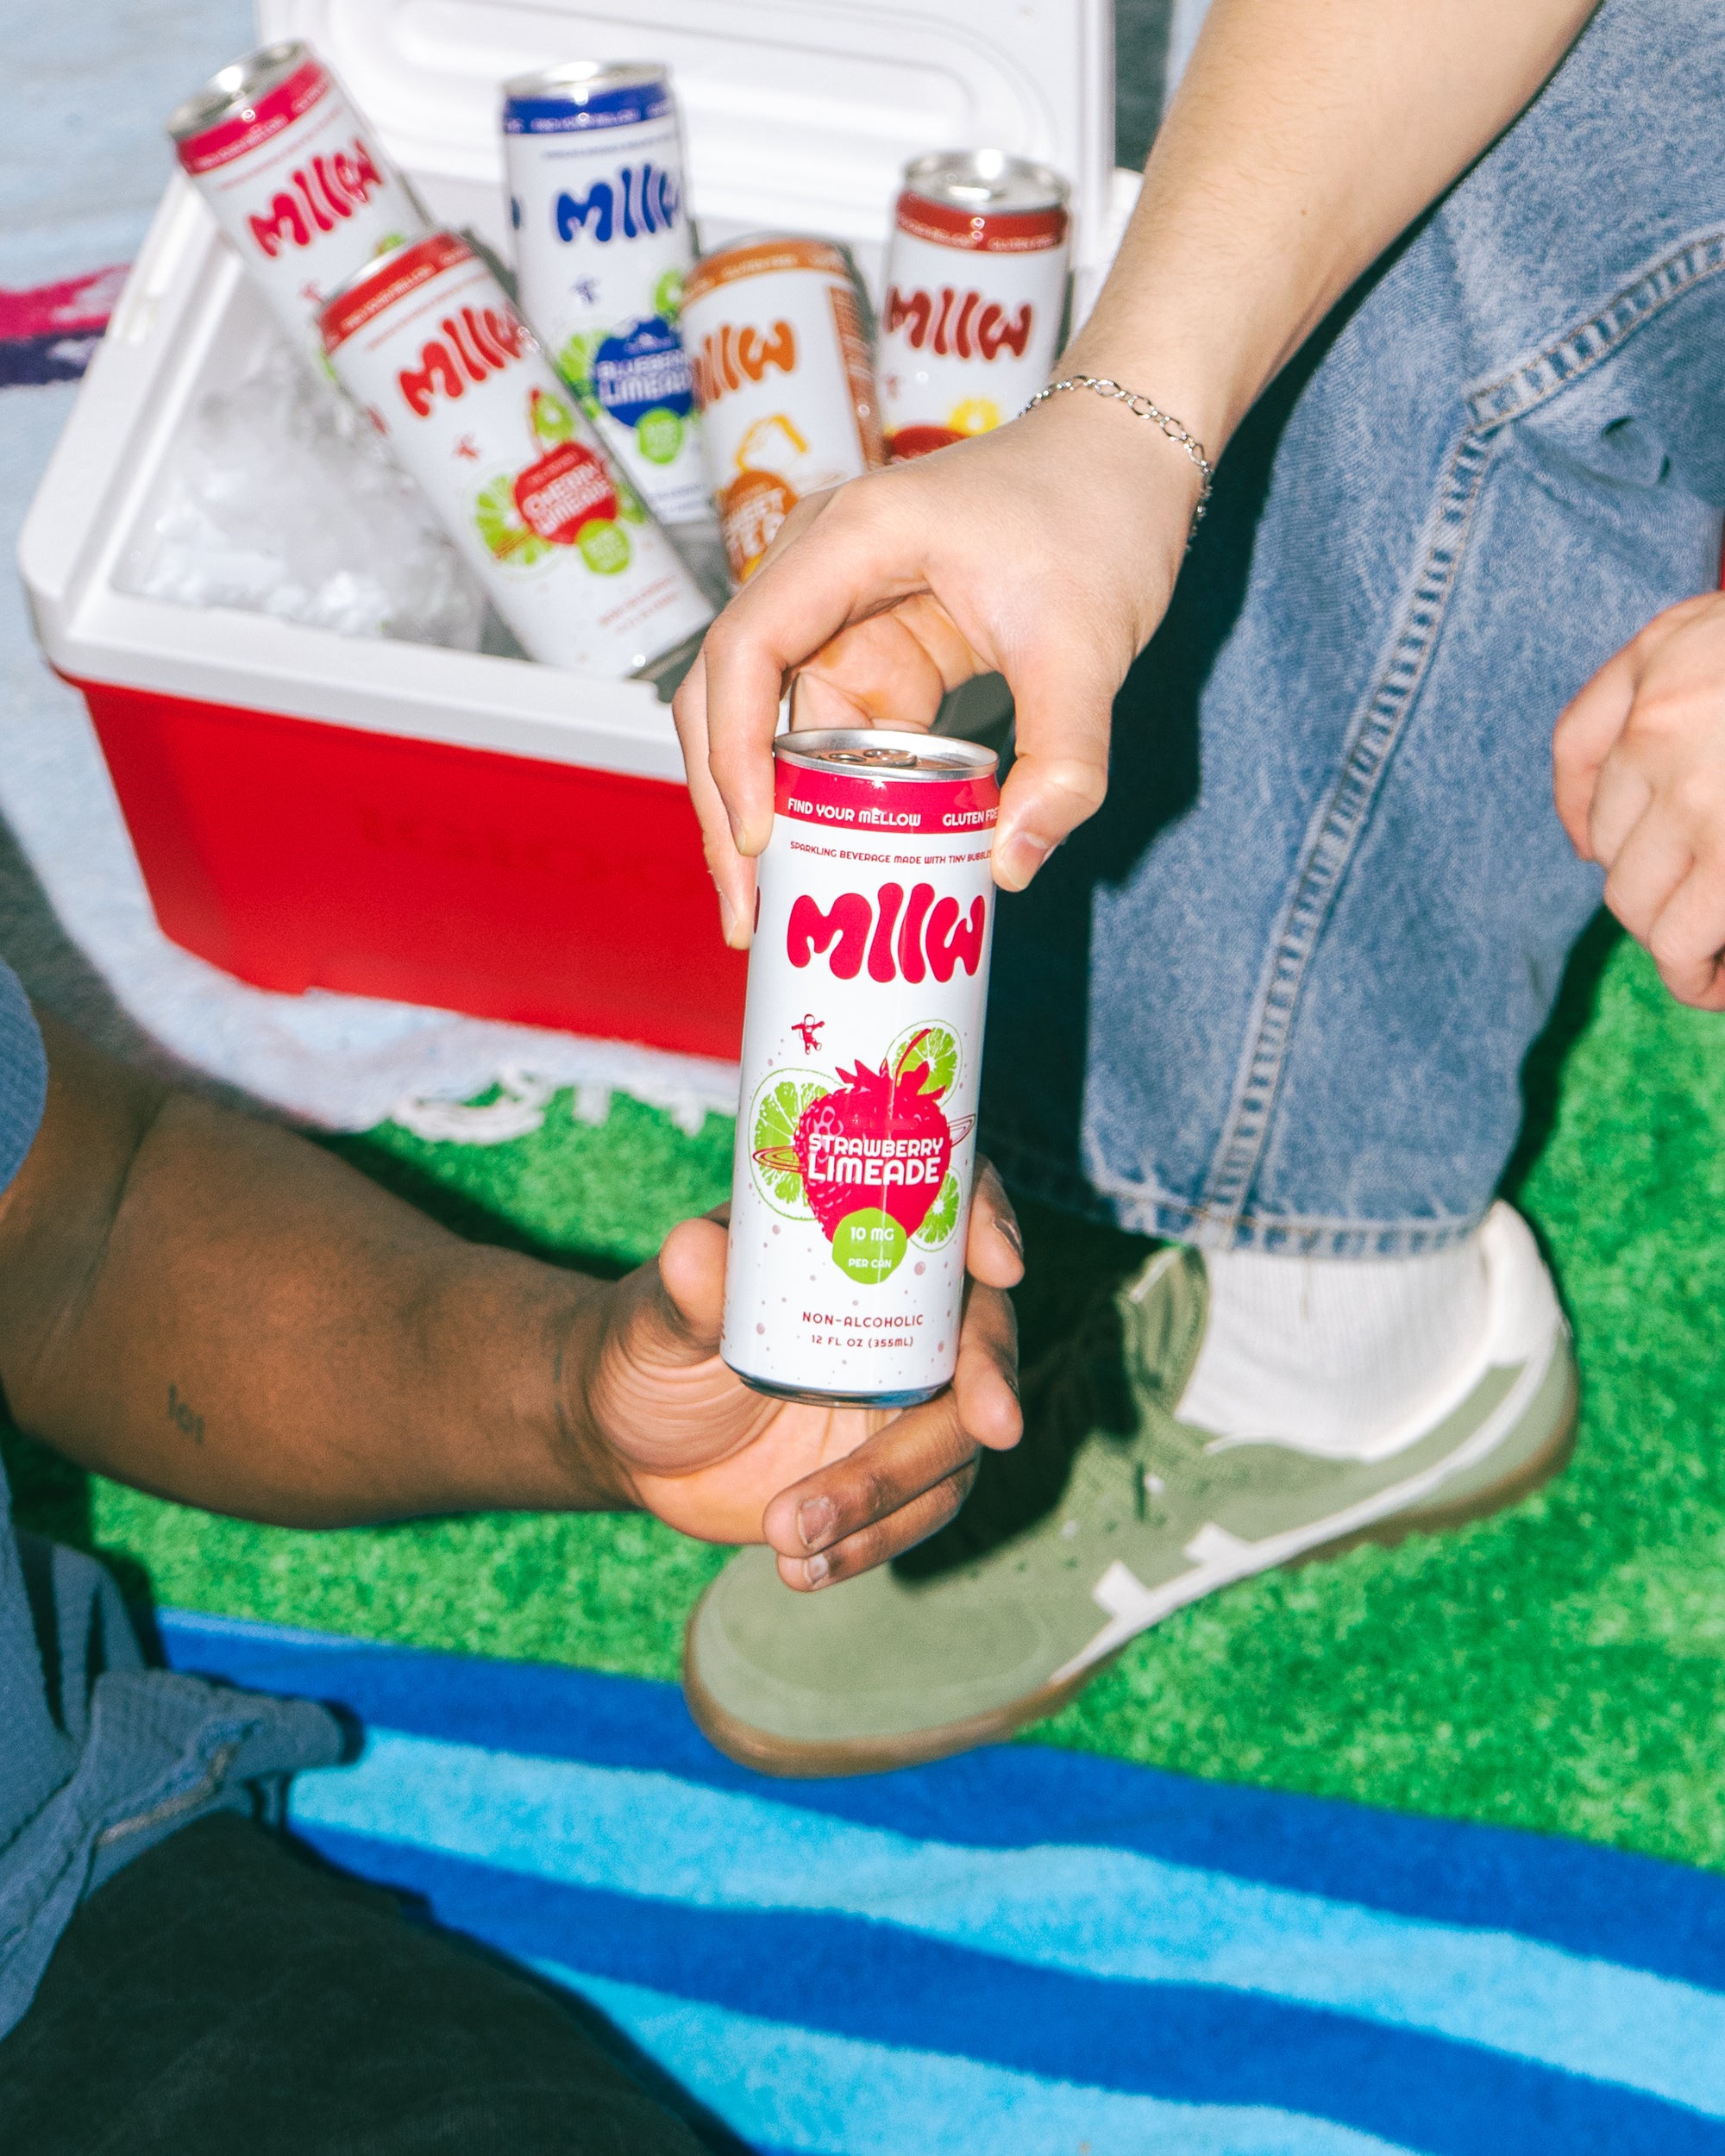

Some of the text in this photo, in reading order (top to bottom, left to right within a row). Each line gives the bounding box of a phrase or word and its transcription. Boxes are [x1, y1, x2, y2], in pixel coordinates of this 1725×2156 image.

[787, 798, 999, 827] FIND YOUR MELLOW GLUTEN FRE
[790, 841, 992, 865] SPARKLING BEVERAGE MADE WITH TINY BUBBLE
[808, 1133, 944, 1158] STRAWBERRY
[807, 1153, 941, 1186] LIMEADE
[850, 1226, 894, 1242] 10 MG
[848, 1257, 892, 1269] PER CAN
[802, 1311, 924, 1328] NON-ALCOHOLIC
[812, 1334, 823, 1344] 12
[828, 1337, 842, 1346] FL
[847, 1338, 862, 1347] OZ
